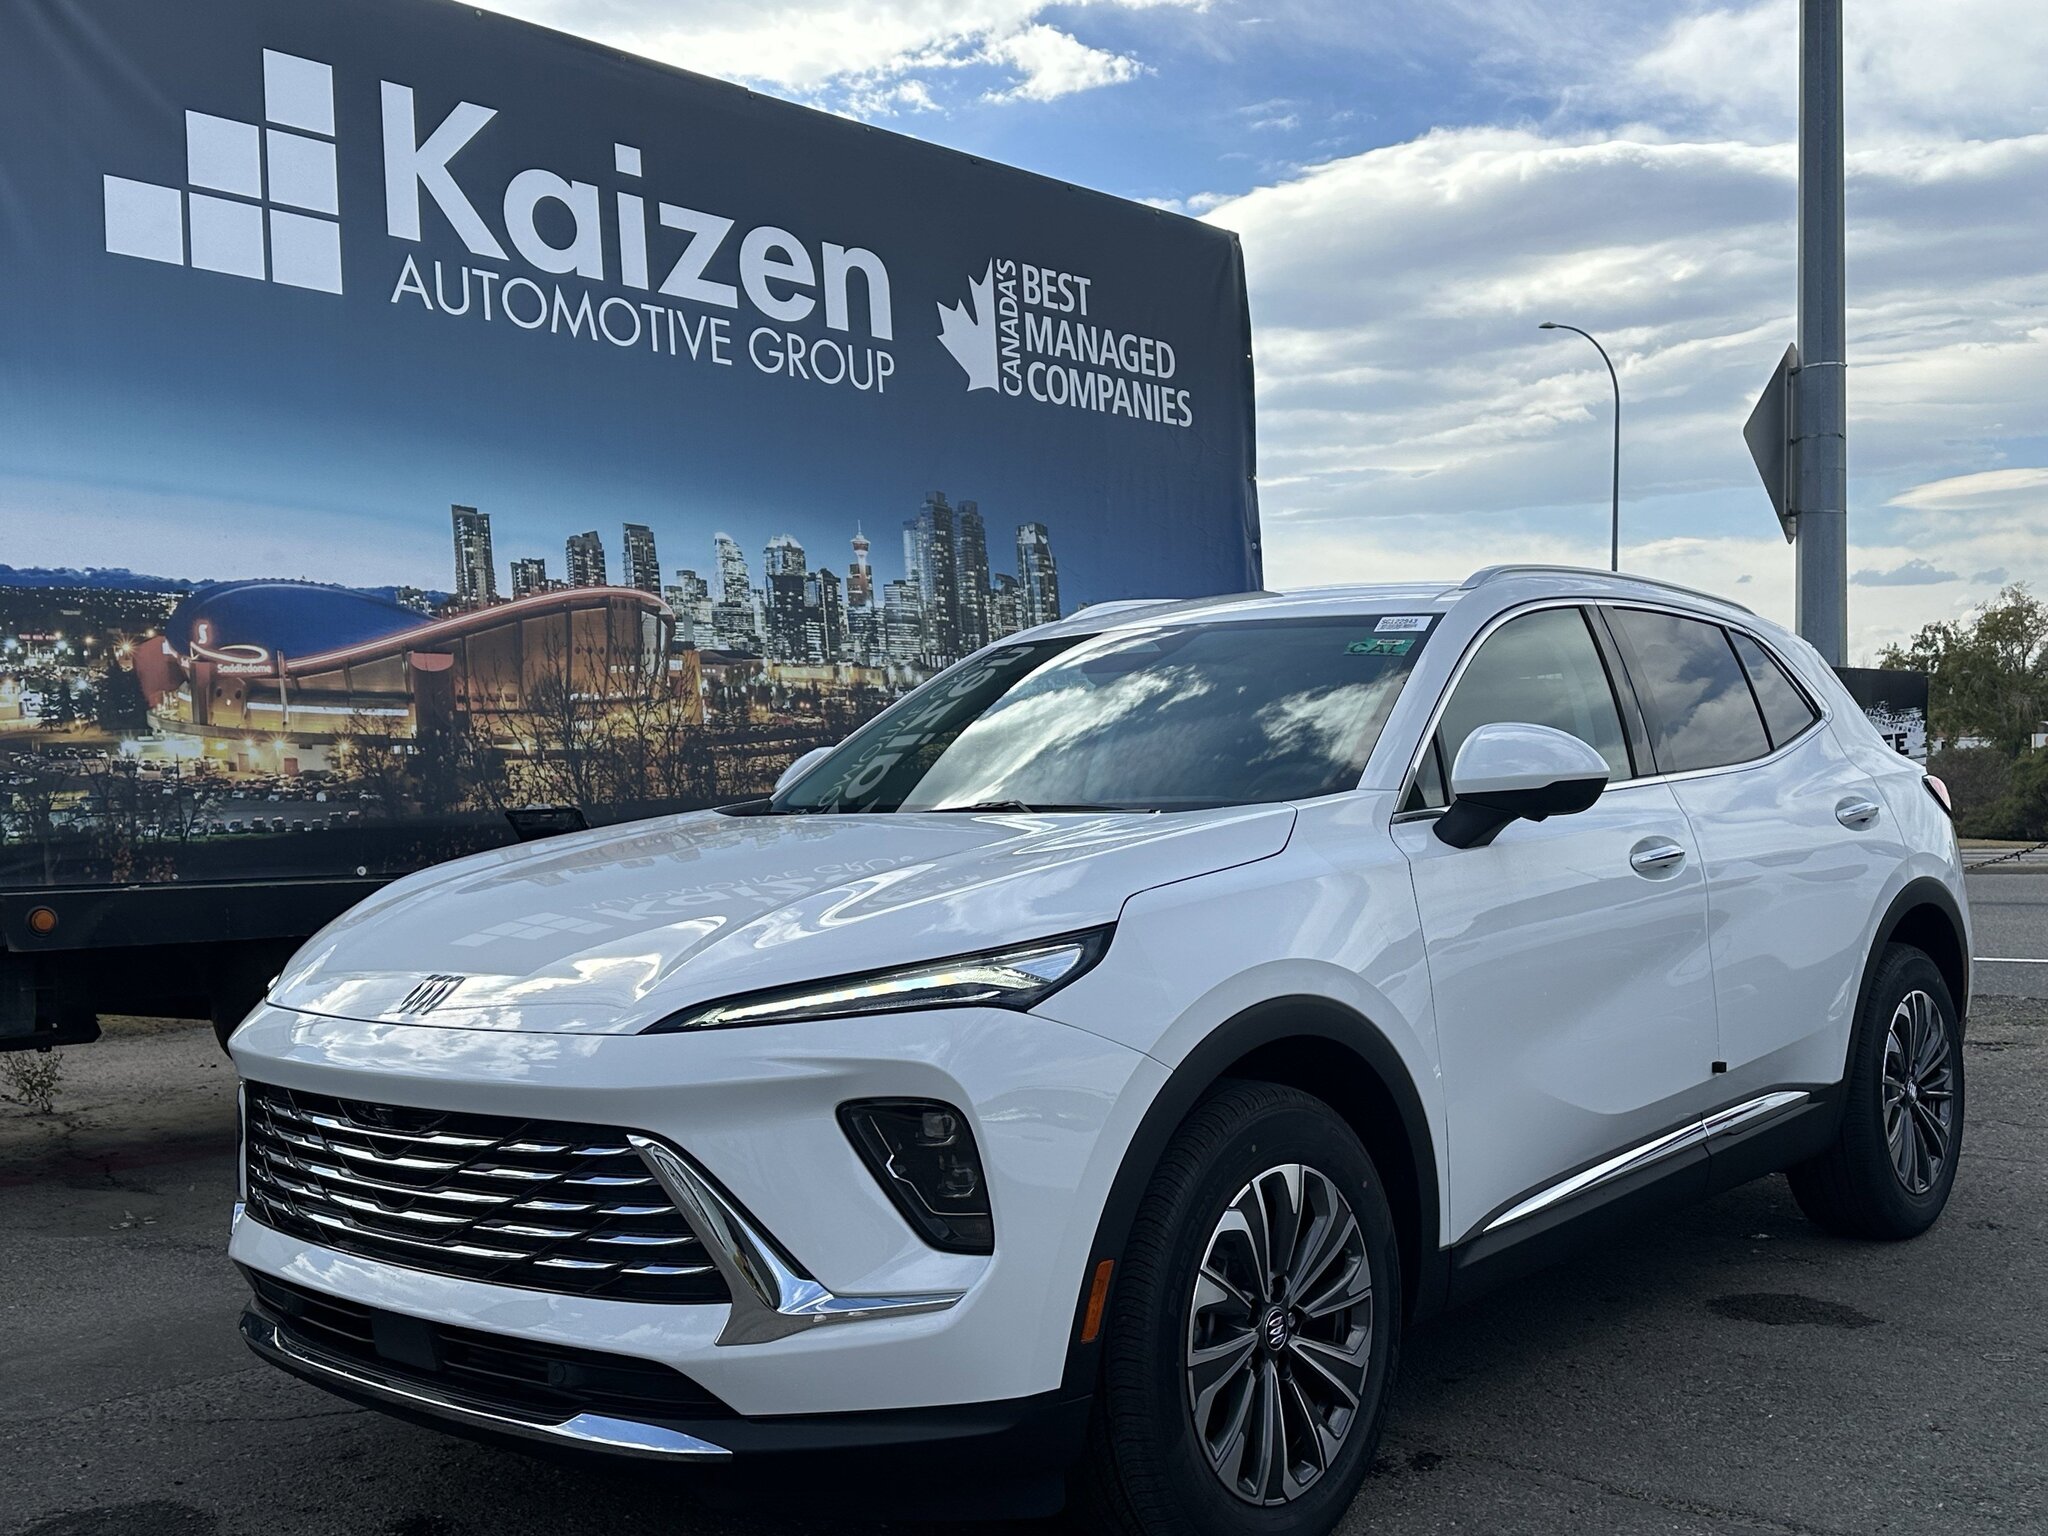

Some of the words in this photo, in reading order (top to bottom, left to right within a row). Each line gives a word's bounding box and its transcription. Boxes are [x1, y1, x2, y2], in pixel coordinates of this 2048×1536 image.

[380, 80, 893, 341] Kaizen
[1022, 263, 1091, 315] BEST
[391, 254, 732, 365] AUTOMOTIVE
[749, 327, 895, 393] GROUP
[996, 258, 1022, 396] CANADA'S
[1024, 312, 1176, 379] MANAGED
[1027, 361, 1193, 427] COMPANIES
[217, 663, 272, 673] Saddledome
